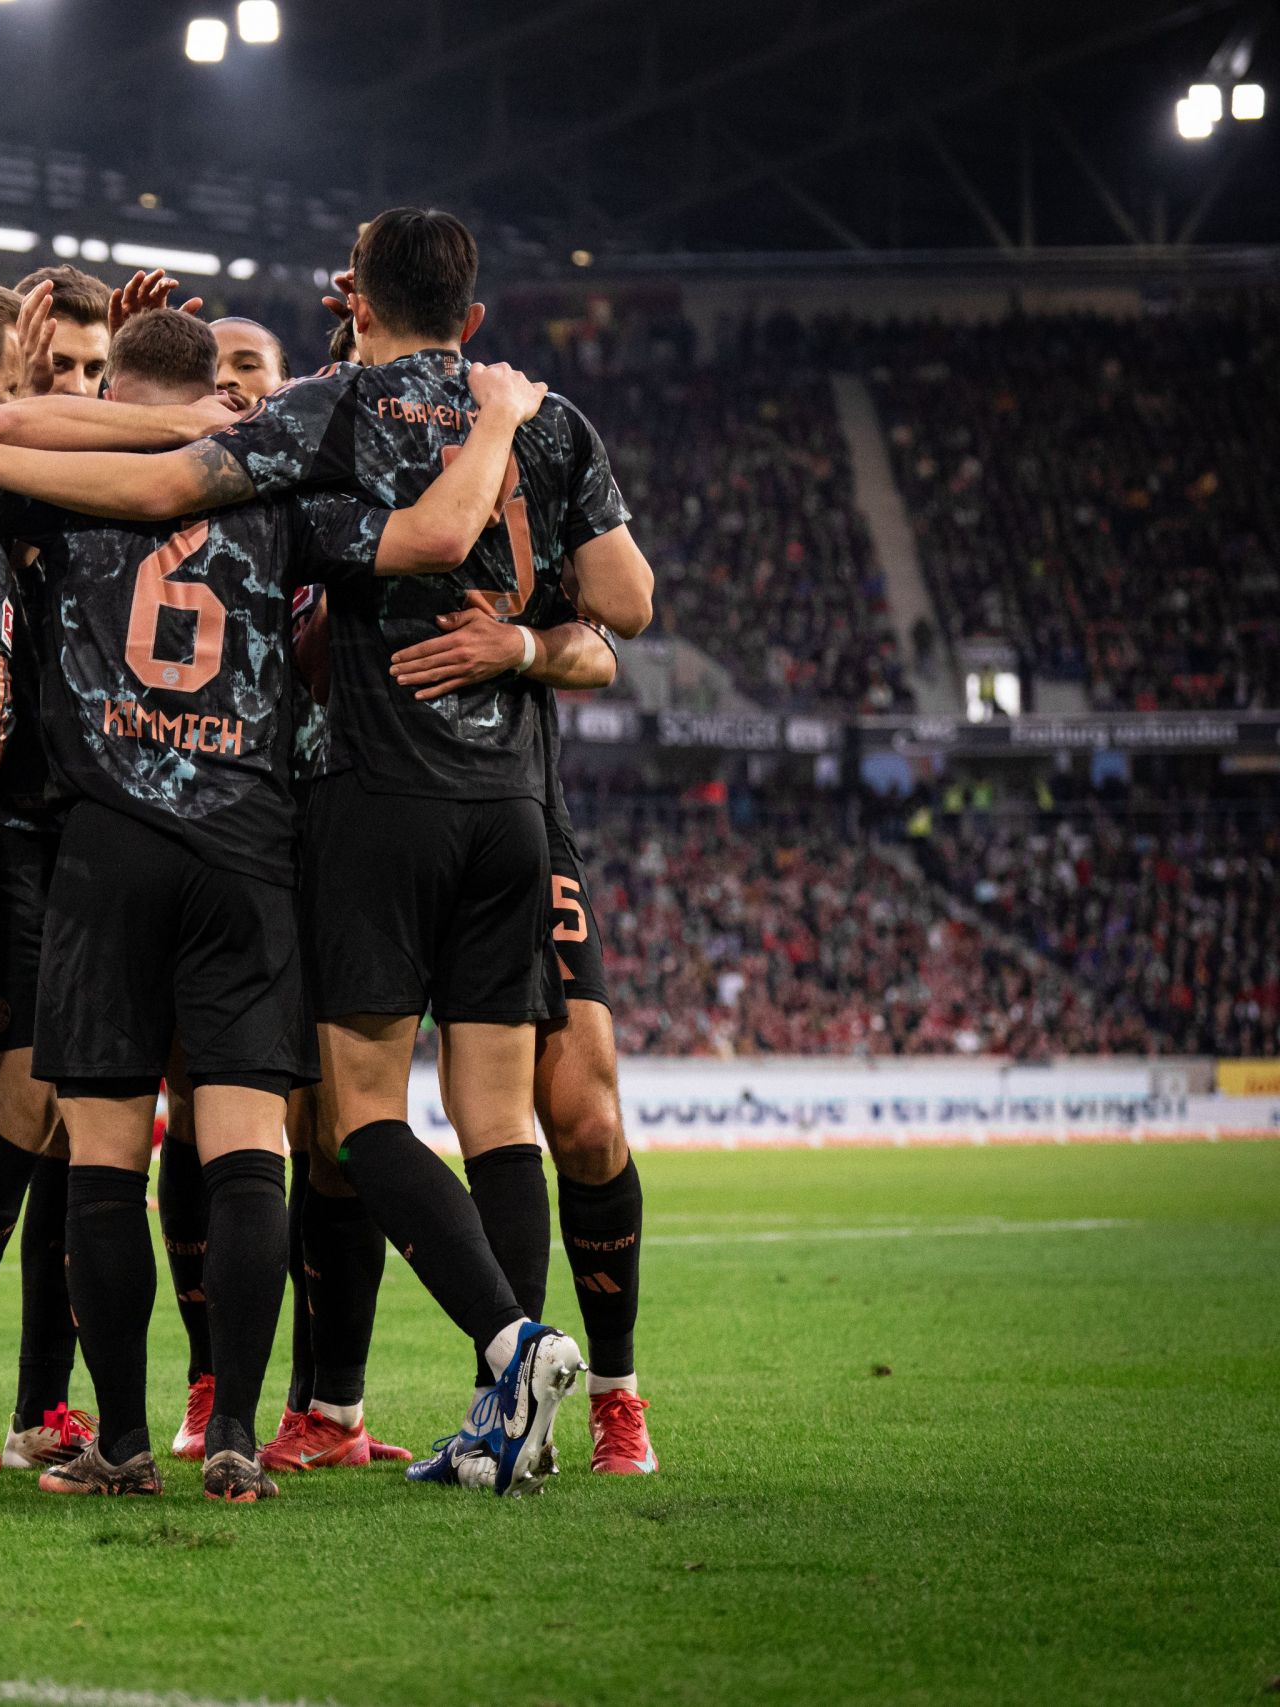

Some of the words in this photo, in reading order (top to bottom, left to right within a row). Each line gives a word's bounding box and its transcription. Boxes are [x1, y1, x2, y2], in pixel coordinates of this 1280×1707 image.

[377, 398, 402, 420] FC
[124, 519, 226, 693] 6
[104, 699, 243, 756] KIMMICH
[552, 874, 588, 943] 5
